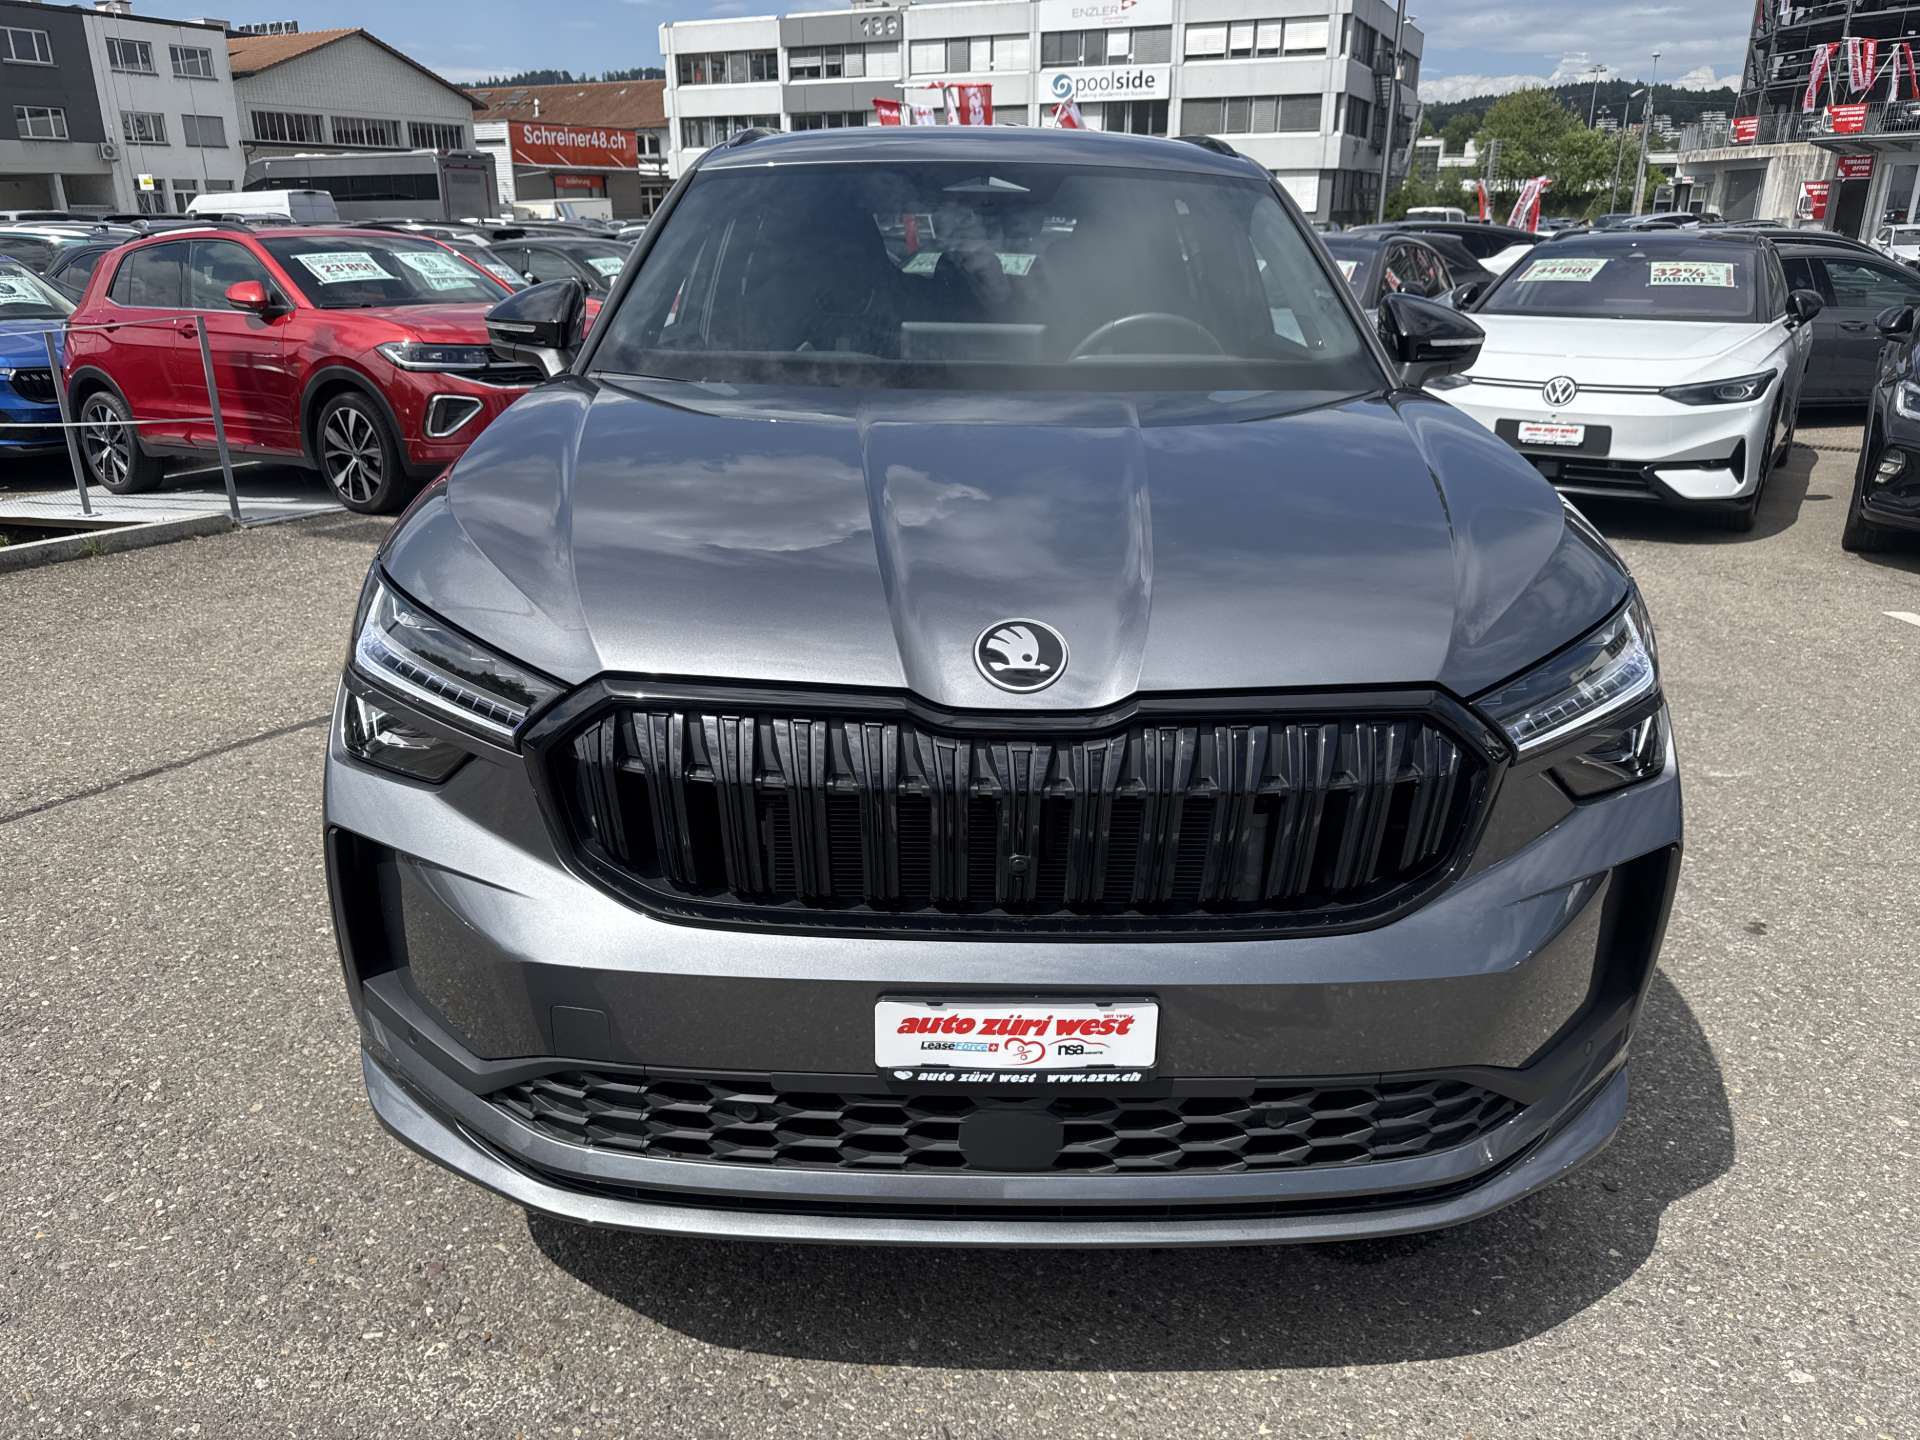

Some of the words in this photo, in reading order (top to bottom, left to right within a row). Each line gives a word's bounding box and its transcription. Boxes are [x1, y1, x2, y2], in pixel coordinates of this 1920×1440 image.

[1071, 5, 1119, 18] ENZLER
[860, 16, 898, 37] 139
[1075, 70, 1155, 98] poolside
[523, 124, 626, 149] Schreiner48.ch
[1653, 267, 1706, 277] 32%
[897, 1013, 976, 1035] auto
[976, 1015, 1054, 1036] züri
[1055, 1016, 1135, 1036] west
[1058, 1044, 1084, 1056] nsa
[917, 1072, 955, 1081] auto
[958, 1072, 995, 1082] züri
[999, 1073, 1037, 1083] west
[1047, 1072, 1142, 1083] www.azw.ch
